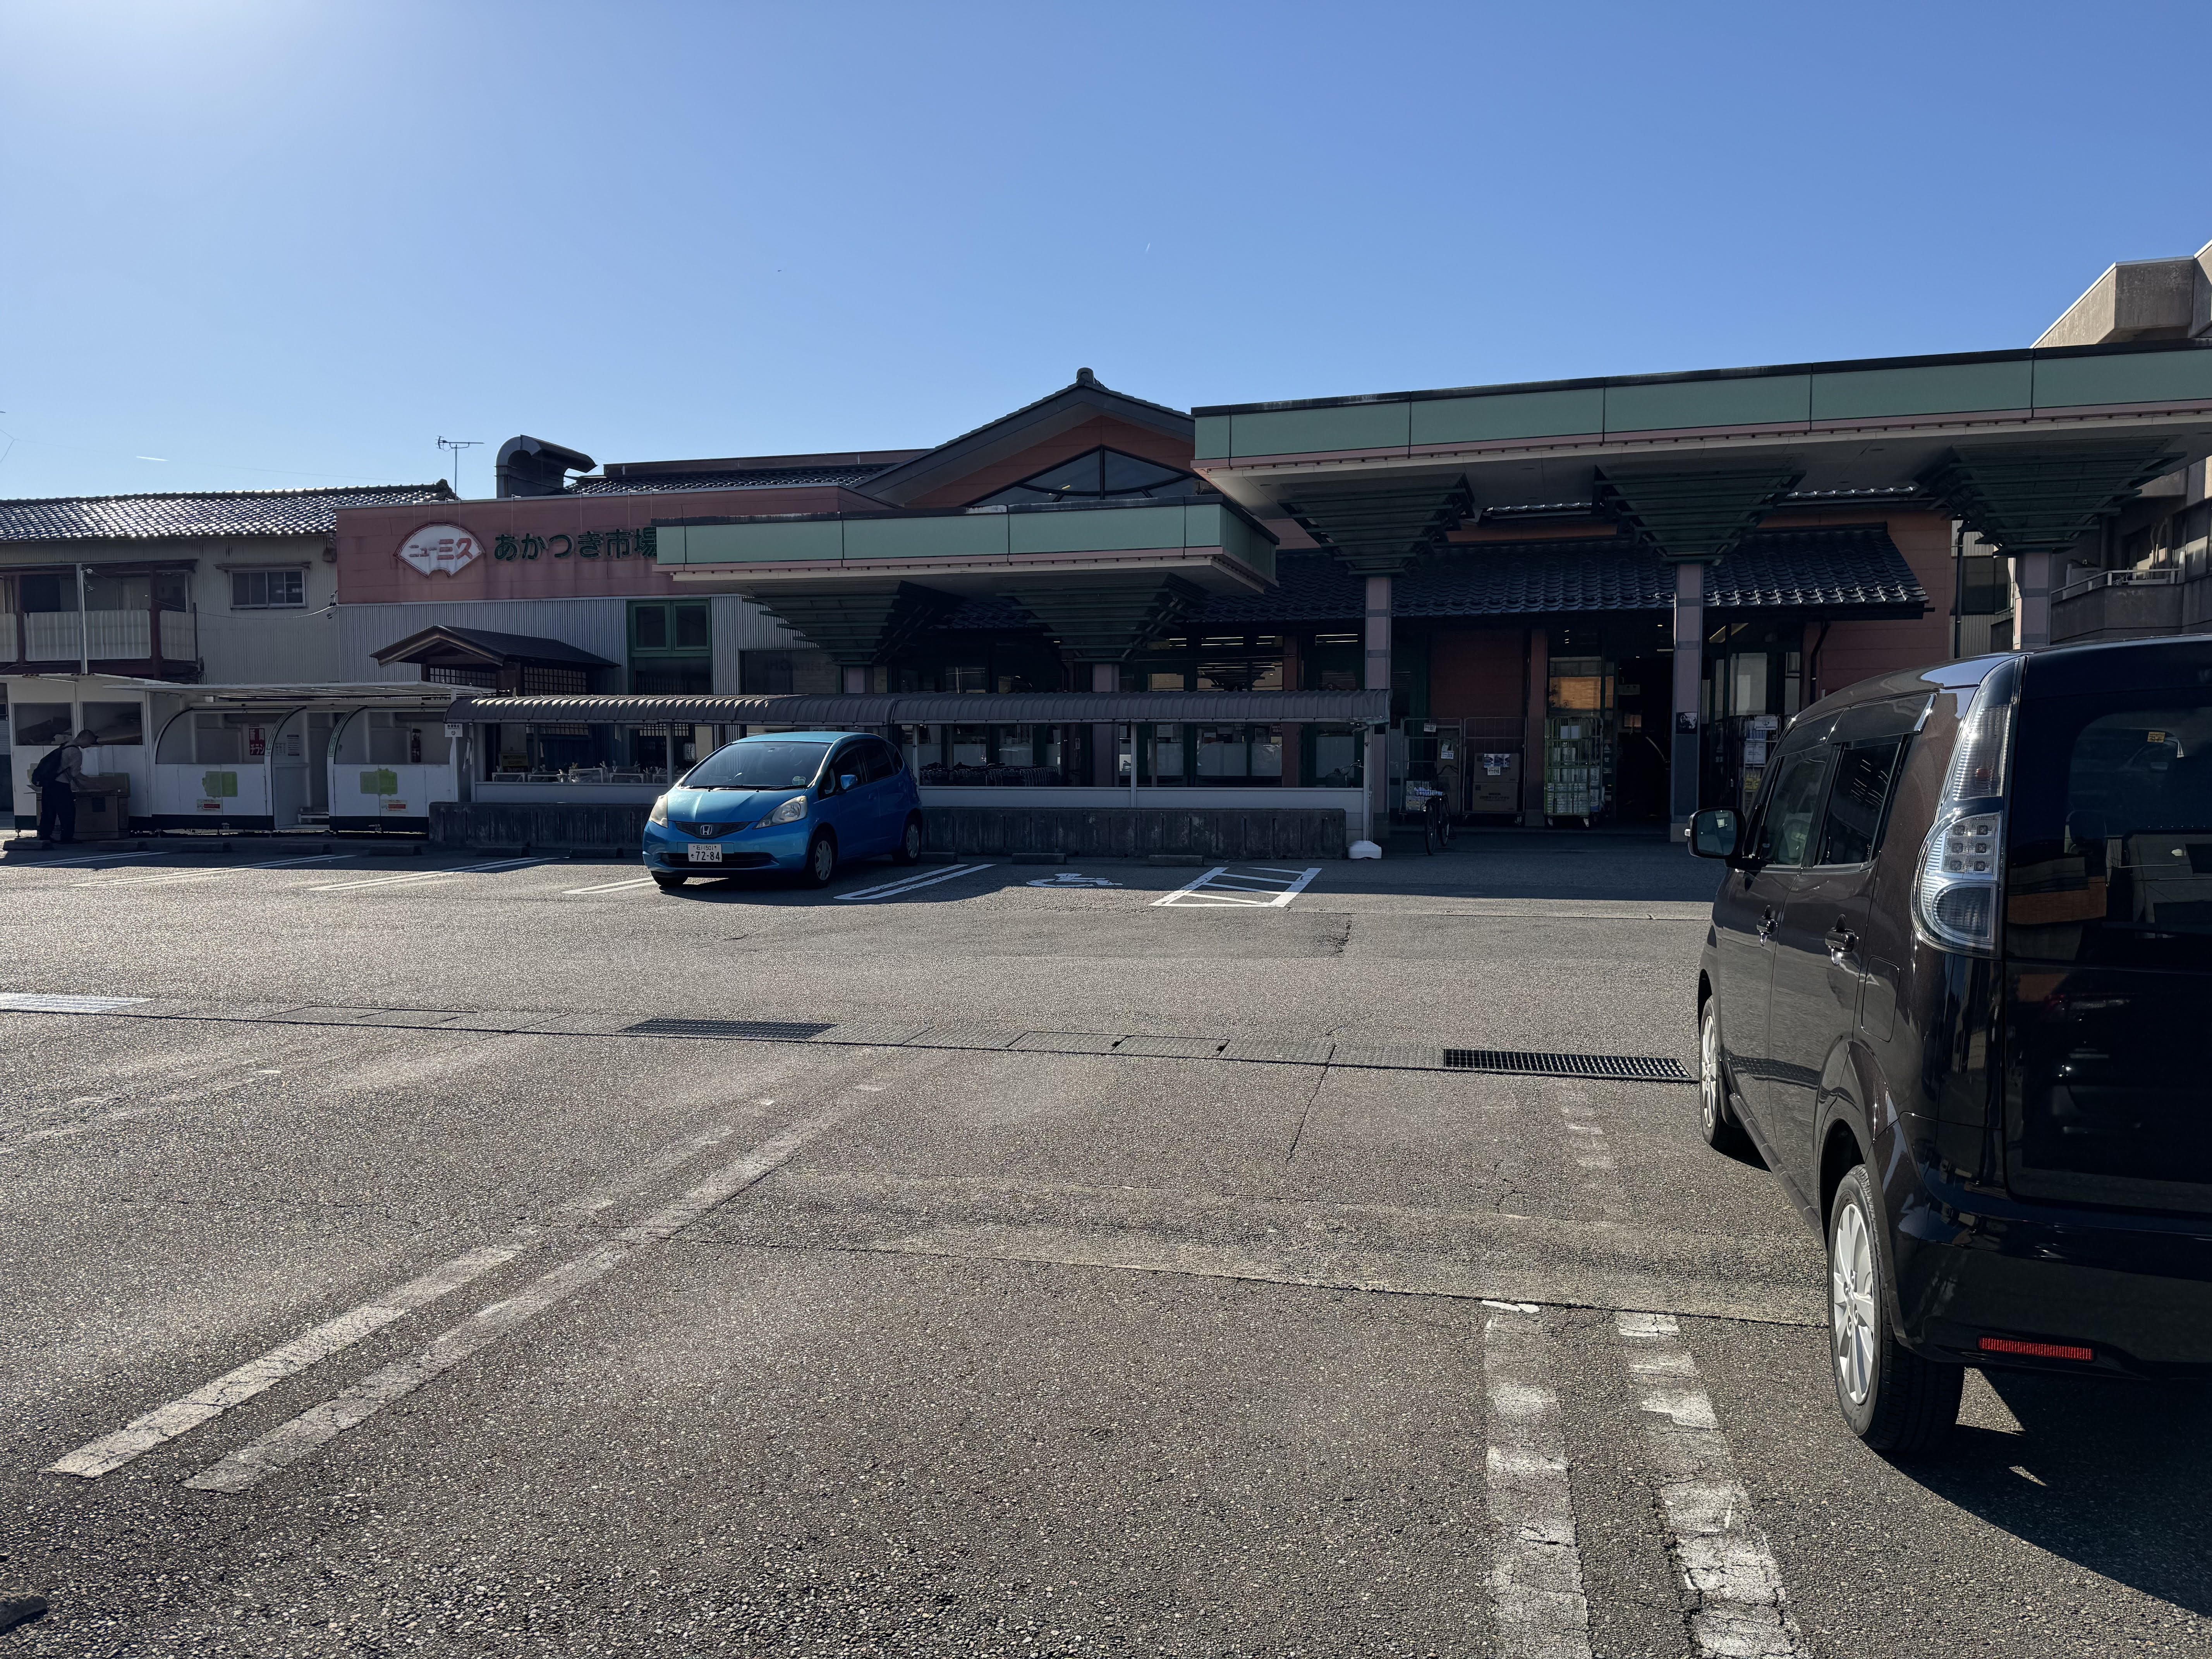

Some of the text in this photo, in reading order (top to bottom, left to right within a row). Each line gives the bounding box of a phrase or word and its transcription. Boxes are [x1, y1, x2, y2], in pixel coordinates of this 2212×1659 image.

[494, 527, 658, 561] あかつき市場
[250, 744, 264, 754] チラシ
[696, 851, 720, 860] 72-84
